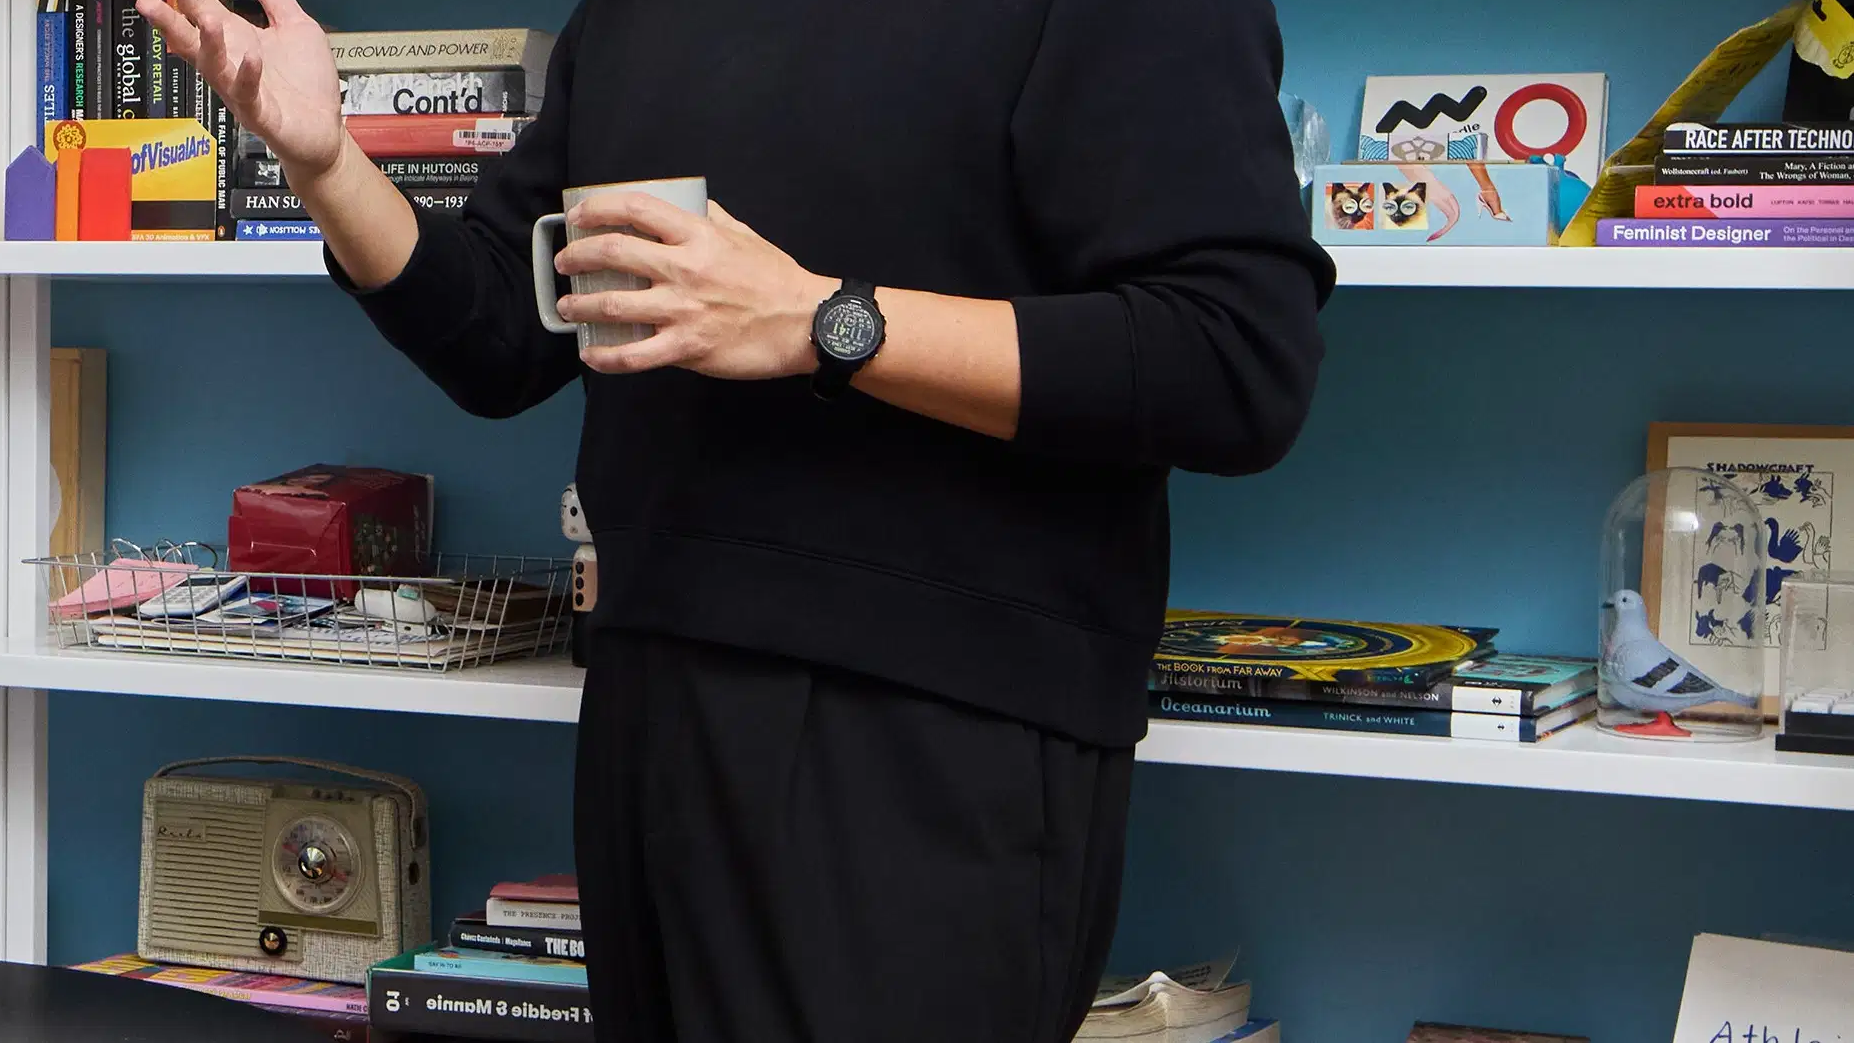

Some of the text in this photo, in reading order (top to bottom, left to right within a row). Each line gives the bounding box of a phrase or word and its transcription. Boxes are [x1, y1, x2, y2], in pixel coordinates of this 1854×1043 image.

[121, 7, 141, 39] the
[75, 4, 84, 108] A DESIGNER'S RESEARCH
[348, 42, 489, 58] CROWDS AND POWER
[116, 43, 141, 103] global
[152, 64, 162, 104] RETAIL
[392, 86, 483, 115] Cont'd
[1685, 129, 1728, 150] RACE
[1731, 129, 1784, 150] AFTER
[217, 106, 226, 210] THE FALL OF PUBLIC MAN
[381, 162, 479, 174] LIFE IN HUTONGS
[1661, 166, 1710, 176] Wollstonecraft
[1784, 161, 1846, 172] Mary, A Fiction
[459, 174, 479, 183] Beijing
[1759, 171, 1852, 182] The Wrongs of Woman,
[246, 195, 280, 209] HAN
[1653, 193, 1754, 209] extra bold
[155, 233, 189, 241] Animation
[1613, 224, 1773, 245] Feminist Designer
[1783, 226, 1845, 235] On the Personal
[1783, 234, 1837, 243] the Political in
[1706, 462, 1815, 474] SHADOWCRAFT
[1156, 662, 1284, 677] THE BOOK FROM FAR AWAY
[1322, 684, 1440, 702] WILKINSON and NELSON
[1160, 695, 1272, 719] Oceanarium
[1323, 711, 1416, 726] TRINICK and WHITE
[502, 909, 557, 920] THE PRESENCE
[545, 936, 567, 956] THE
